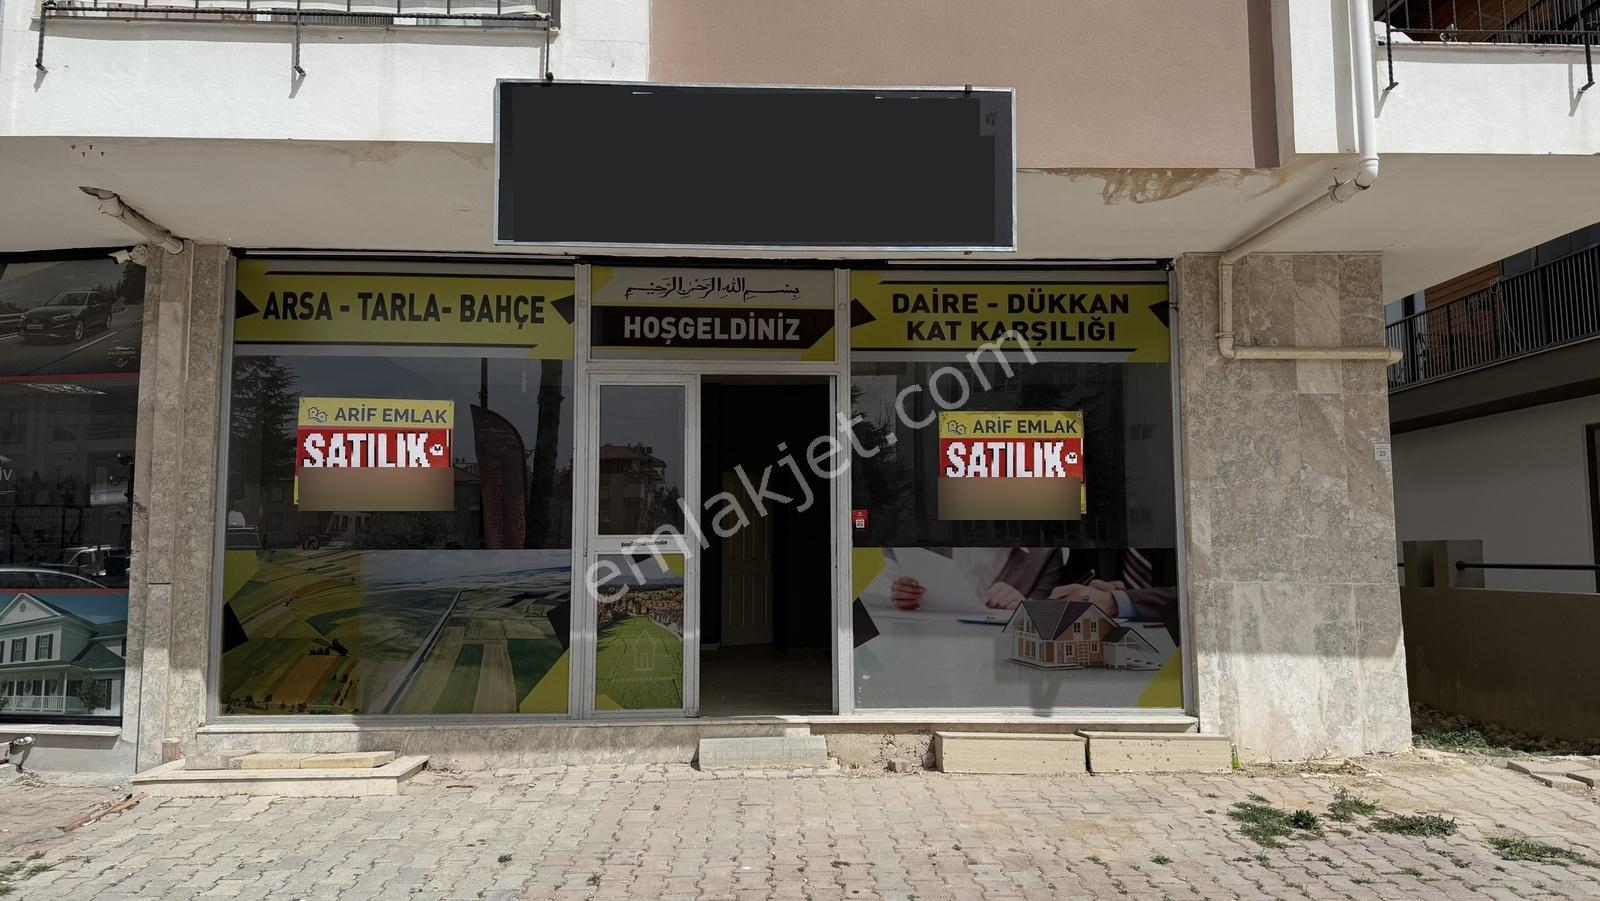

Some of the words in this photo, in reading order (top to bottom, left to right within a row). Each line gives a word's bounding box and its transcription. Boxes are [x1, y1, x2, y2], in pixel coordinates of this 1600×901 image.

[263, 291, 332, 321] ARSA
[460, 294, 545, 330] BAHÇE
[892, 288, 978, 314] DAİRE
[1008, 288, 1129, 314] DÜKKAN
[624, 311, 800, 345] HOŞGELDİNİZ
[907, 320, 962, 341] KAT
[971, 316, 1115, 346] KARŞILIĞI
[334, 404, 377, 422] ARİF
[382, 408, 448, 424] EMLAK
[973, 416, 1012, 433] ARİF
[1017, 419, 1078, 434] EMLAK
[303, 432, 431, 468] SATILIK
[946, 441, 1066, 478] SATILIK
